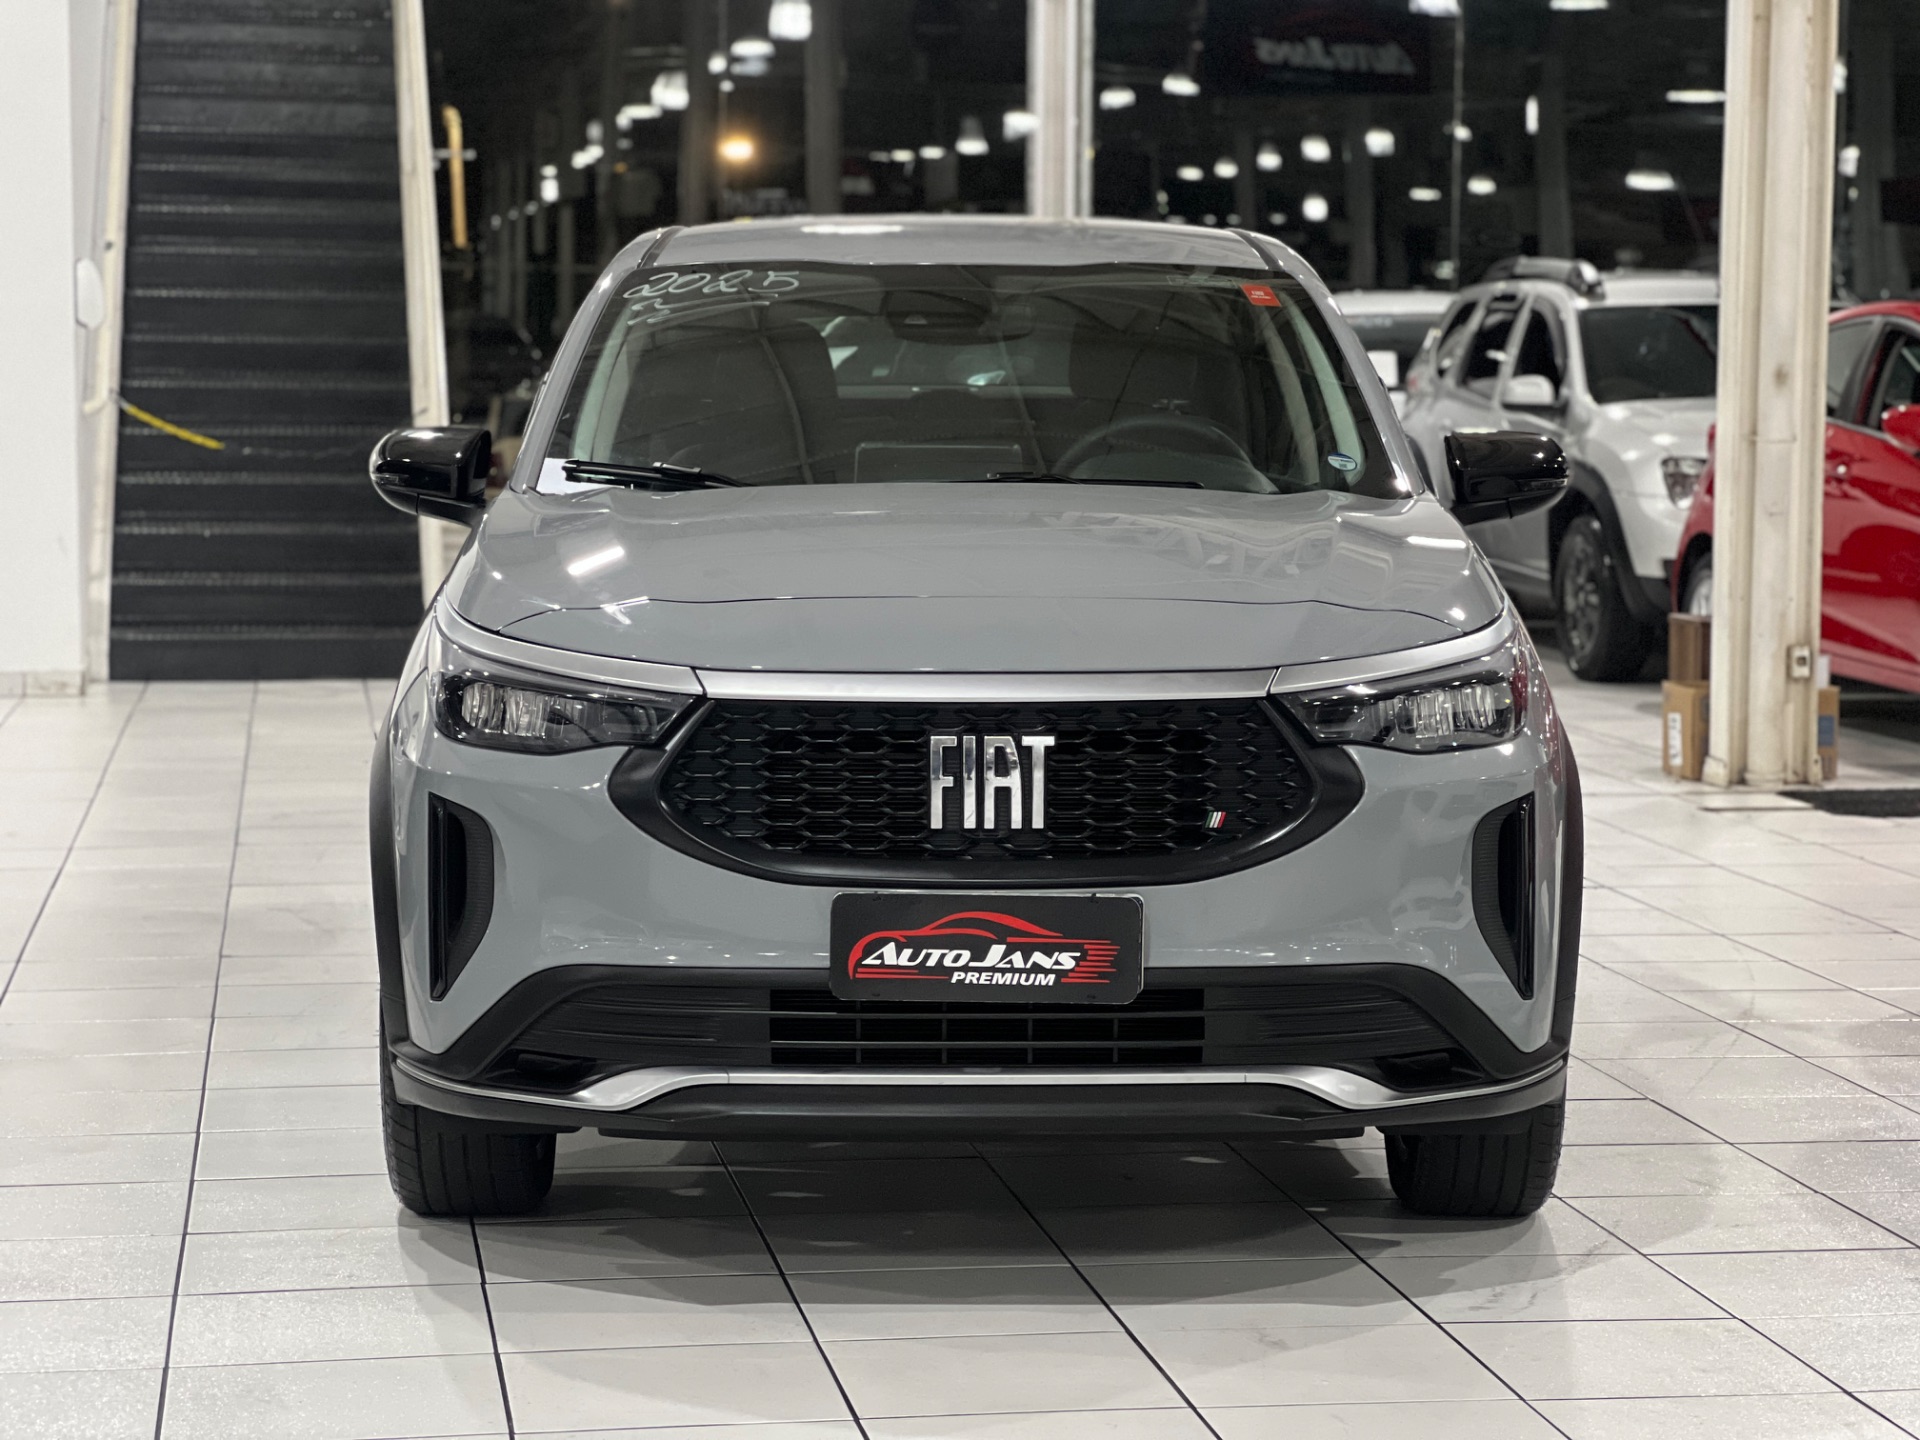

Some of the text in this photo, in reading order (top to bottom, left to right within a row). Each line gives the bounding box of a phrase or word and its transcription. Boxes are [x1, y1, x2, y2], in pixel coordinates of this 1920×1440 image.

[623, 270, 800, 299] 2025
[930, 735, 1055, 829] FIAT
[950, 971, 1056, 987] PREMIUM
